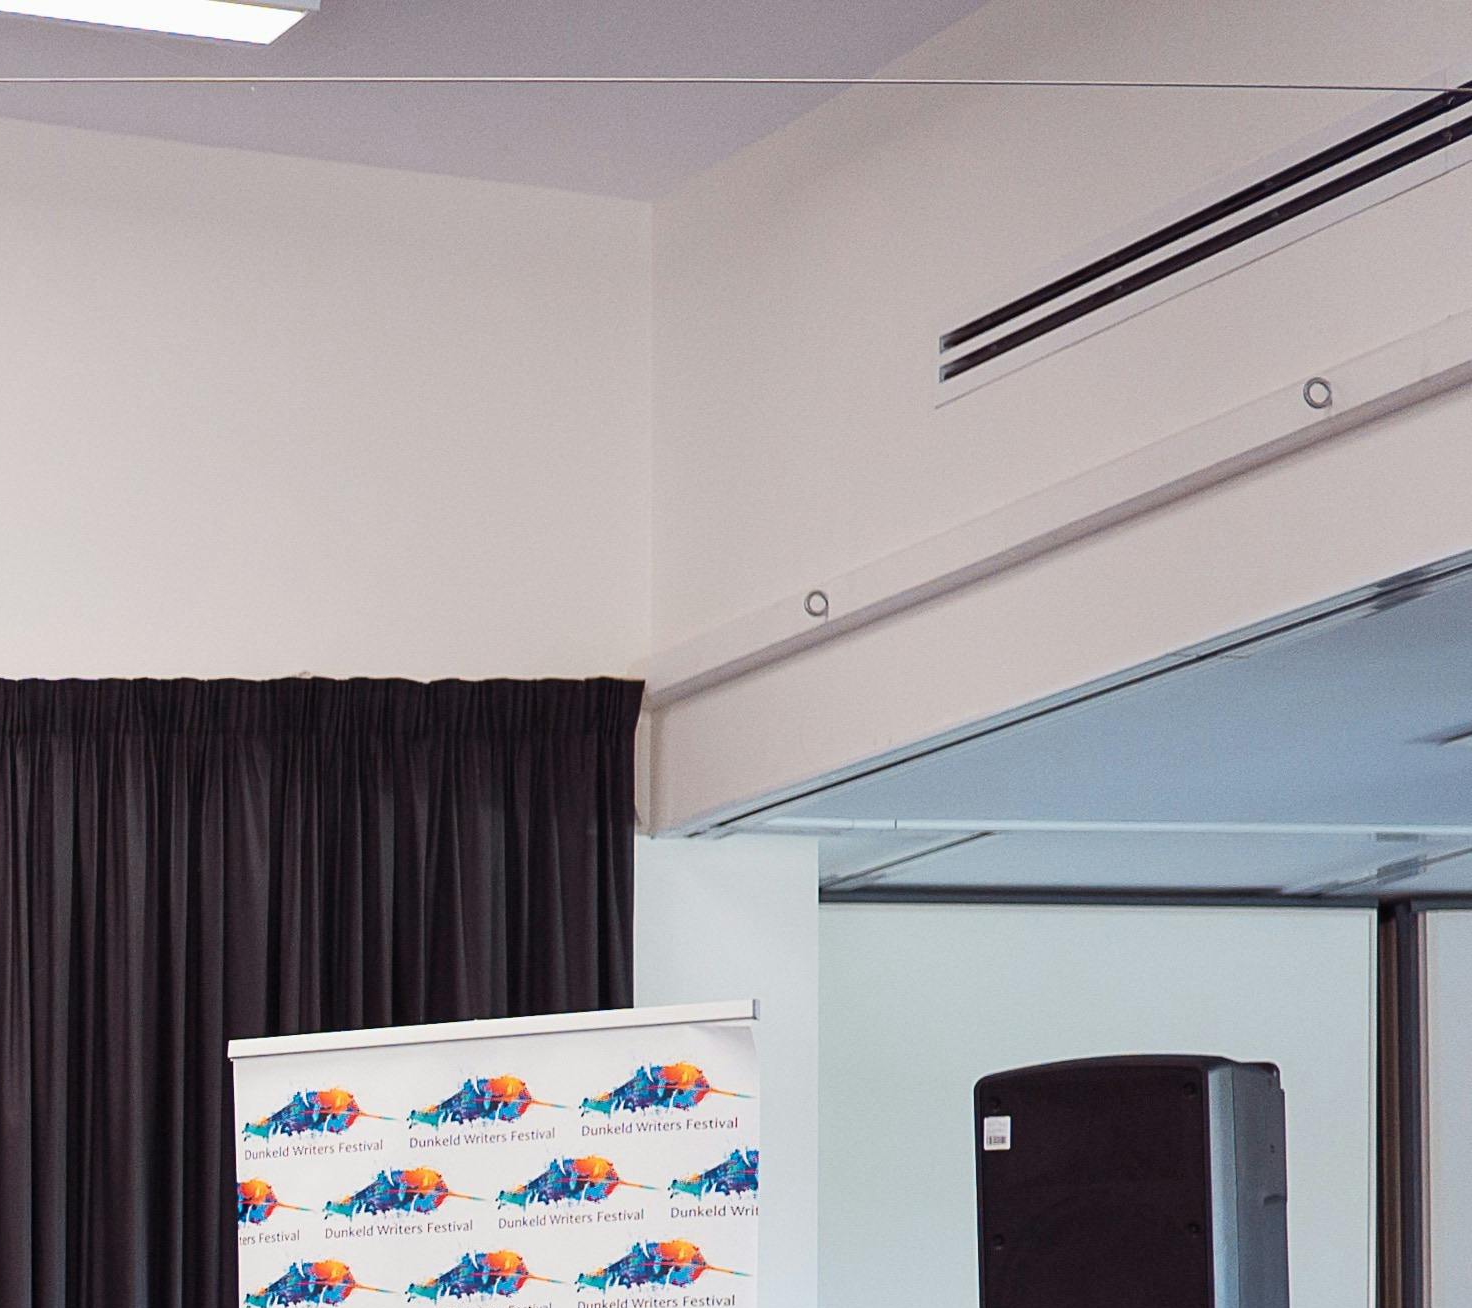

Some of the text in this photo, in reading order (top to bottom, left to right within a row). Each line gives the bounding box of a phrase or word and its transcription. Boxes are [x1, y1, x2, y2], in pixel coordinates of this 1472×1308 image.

[581, 1116, 738, 1137] Dunkeld Writers Festival
[409, 1127, 555, 1149] Dunkeld Writers Festival
[244, 1139, 383, 1161] Dunkeld Writers Festival
[498, 1207, 644, 1229] Dunkeld Writers Festival
[670, 1205, 727, 1219] Dunkeld
[258, 1229, 300, 1244] Festival
[325, 1219, 473, 1239] Dunkeld Writers Festival
[631, 1298, 679, 1308] Writers
[682, 1294, 736, 1307] Festival
